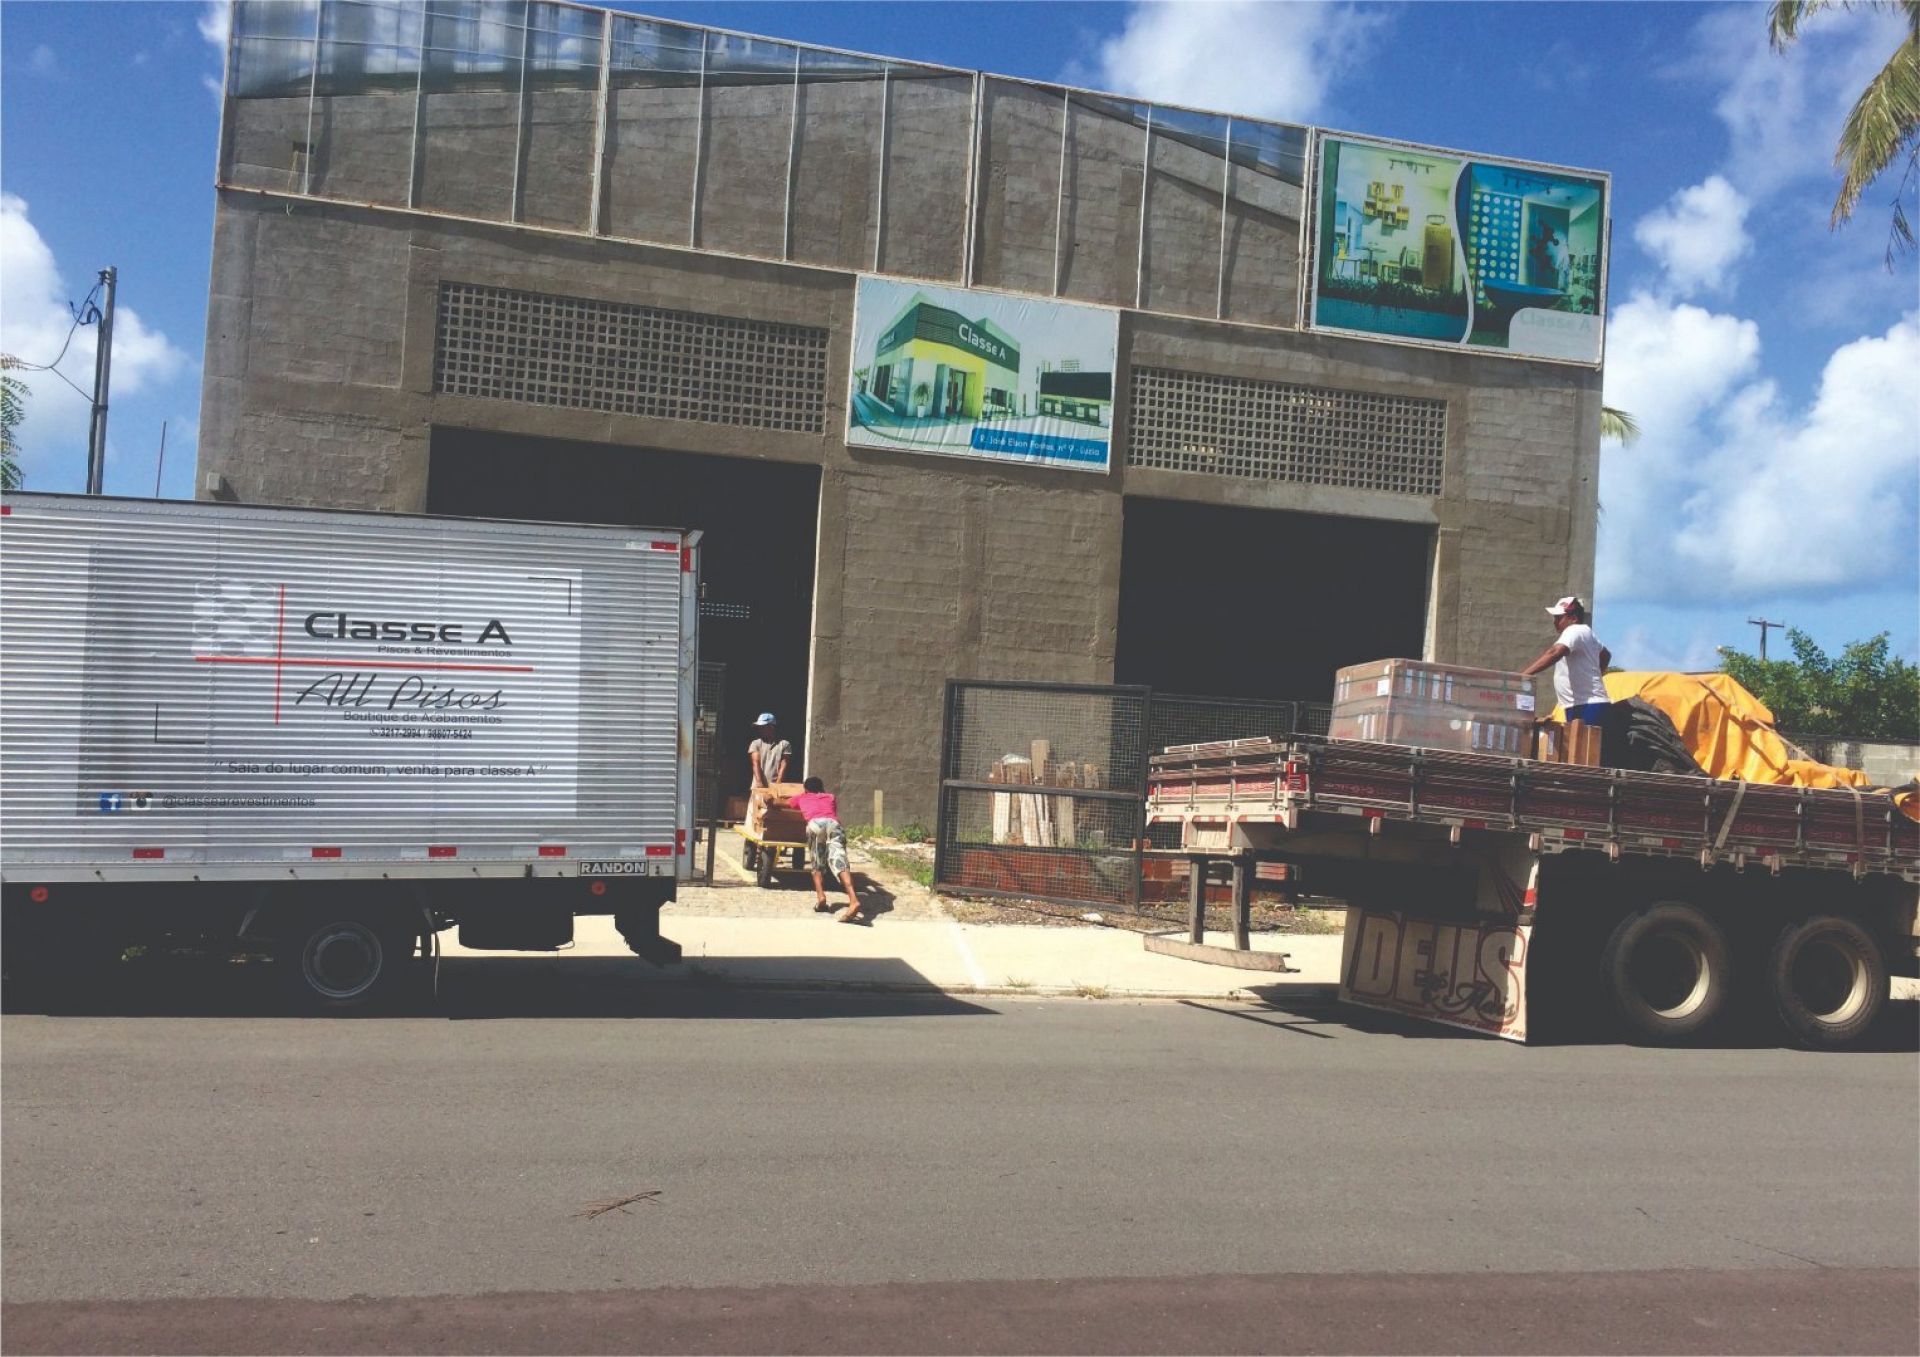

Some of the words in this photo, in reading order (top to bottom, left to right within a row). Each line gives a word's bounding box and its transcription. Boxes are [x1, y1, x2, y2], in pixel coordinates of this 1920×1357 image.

[958, 323, 997, 356] Classe
[999, 346, 1007, 361] A
[304, 612, 463, 644] Classe
[477, 619, 513, 645] A
[378, 645, 411, 655] Pisos
[414, 646, 423, 655] &
[426, 646, 513, 658] Revestimentos
[296, 672, 378, 706] All
[387, 675, 508, 710] Pisos
[343, 710, 400, 723] Boutique
[402, 712, 417, 723] de
[422, 713, 503, 725] Acabamentos
[265, 761, 284, 774] do
[289, 762, 325, 777] lugar
[331, 764, 390, 777] comum,
[397, 764, 440, 776] venha
[444, 766, 475, 779] para
[480, 765, 522, 776] classe
[162, 795, 316, 808] @classearevestimentos
[580, 862, 646, 874] RANDON
